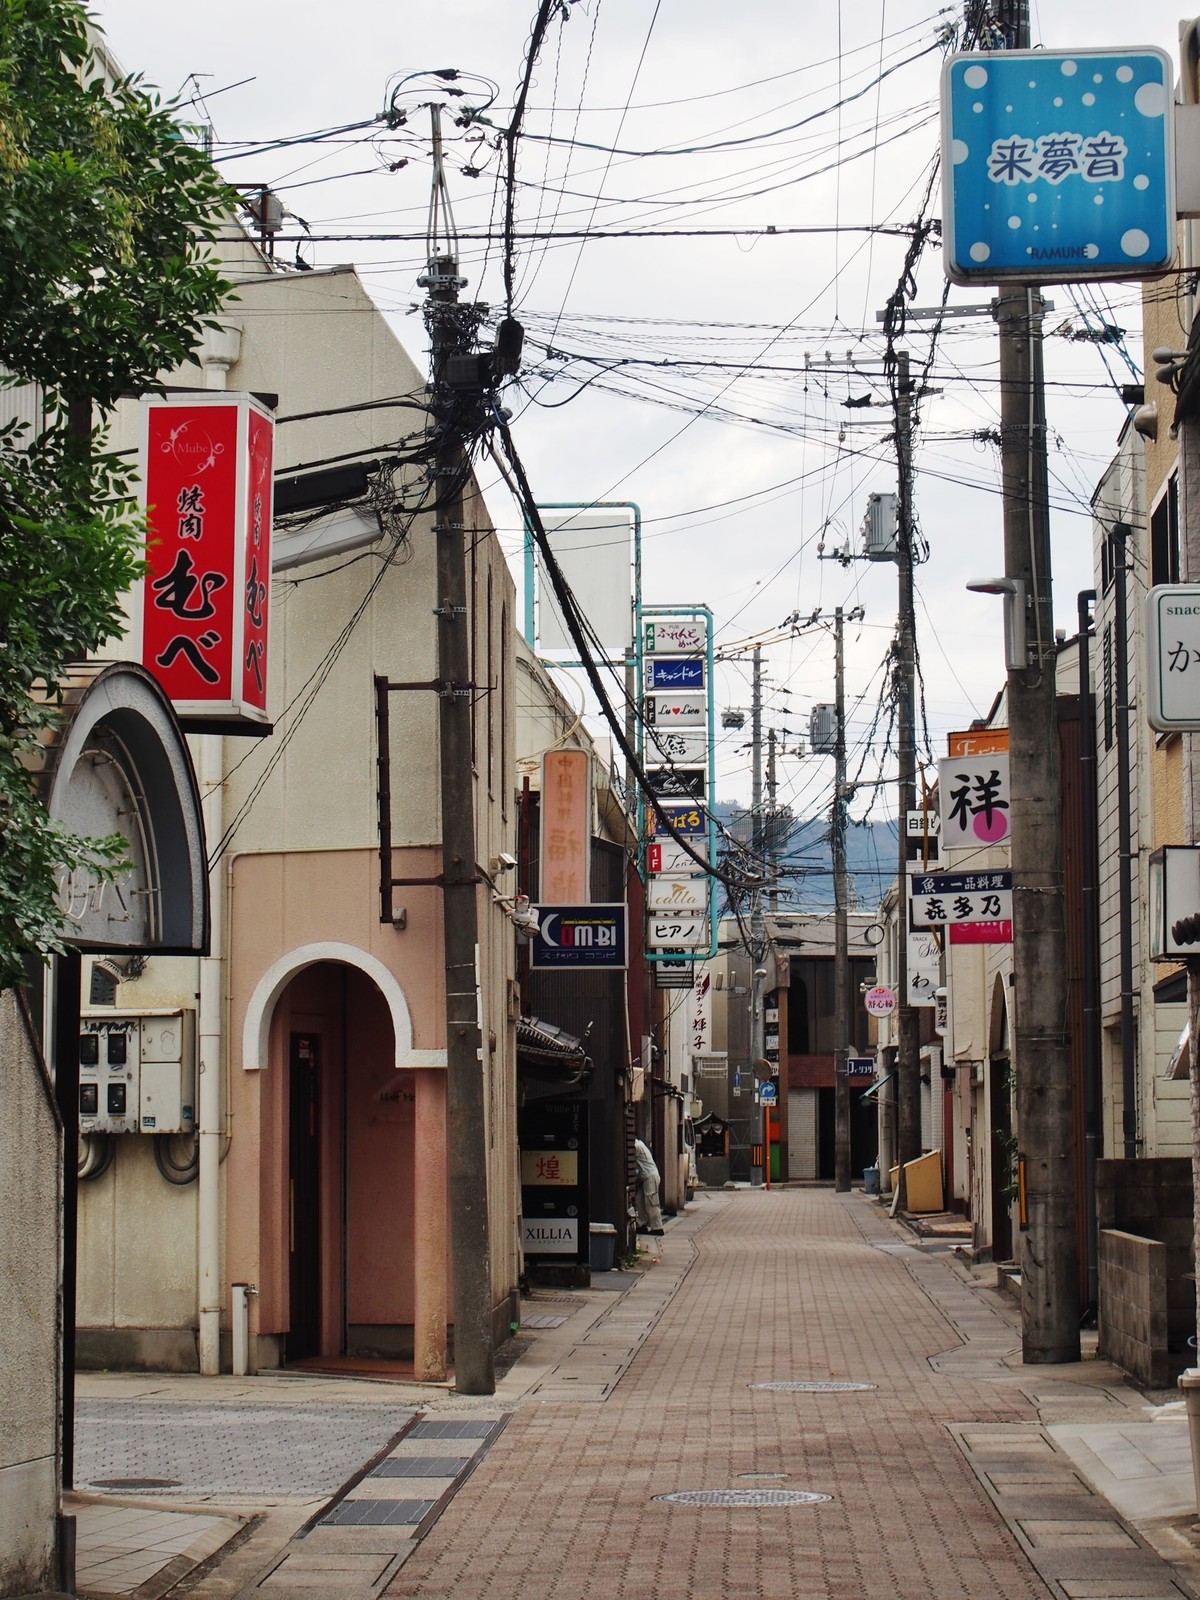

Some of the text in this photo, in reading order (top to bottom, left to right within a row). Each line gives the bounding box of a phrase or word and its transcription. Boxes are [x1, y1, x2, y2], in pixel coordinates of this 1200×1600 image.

[988, 134, 1126, 184] 来夢音
[1030, 246, 1089, 260] RAMUNE
[178, 442, 209, 453] Mube
[177, 484, 205, 541] 焼肉
[252, 492, 262, 550] 焼肉
[152, 547, 227, 685] むべ
[246, 554, 267, 693] むべ
[647, 627, 654, 649] 4F
[647, 666, 653, 683] 3F
[656, 667, 701, 682] キャンドル
[649, 701, 654, 720] 3F
[680, 703, 700, 715] Lien
[949, 770, 1010, 831] 祥
[667, 811, 700, 828] ばる
[651, 848, 659, 868] 1F
[920, 874, 1004, 894] 魚・一品料理
[655, 890, 698, 904] calla
[656, 925, 695, 938] ピアノ
[692, 1018, 707, 1050] 輝子
[536, 1155, 560, 1179] 煌
[526, 1228, 573, 1239] XILLIA
